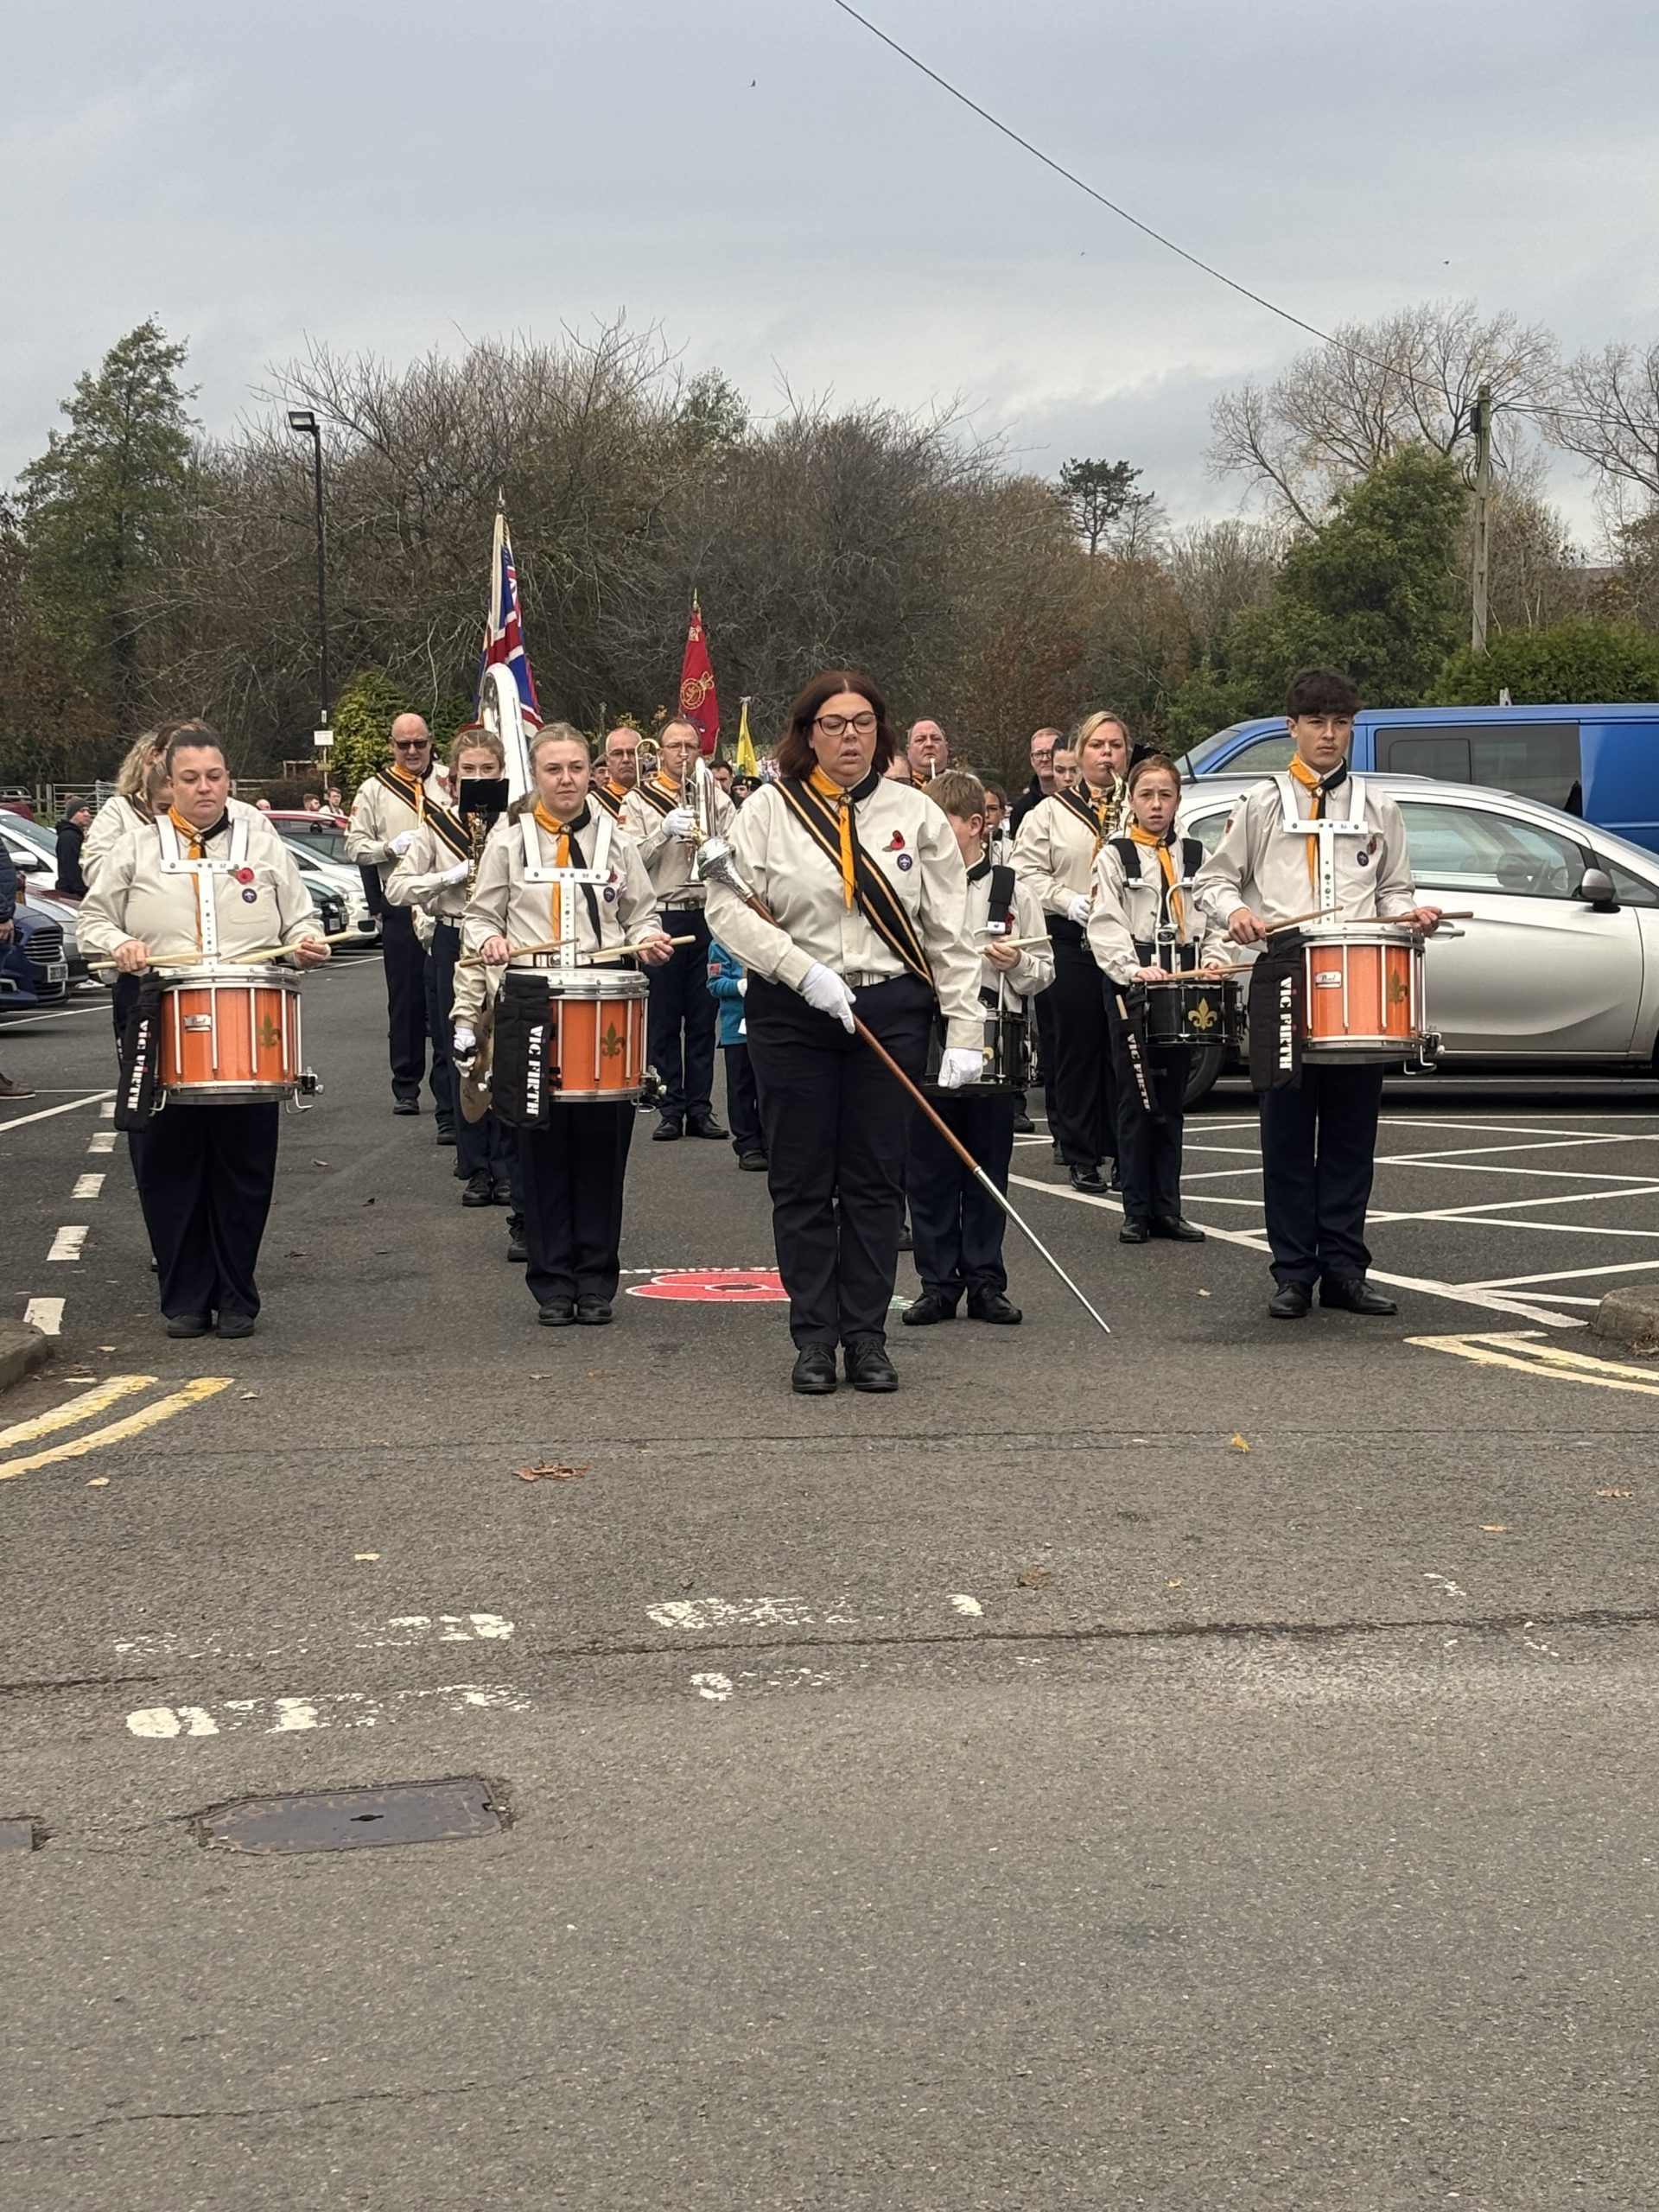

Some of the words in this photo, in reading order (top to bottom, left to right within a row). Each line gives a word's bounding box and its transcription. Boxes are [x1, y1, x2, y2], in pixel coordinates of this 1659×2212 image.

[1279, 976, 1292, 1008] VIC
[137, 1020, 149, 1050] VIC
[528, 1025, 543, 1055] VIC
[1127, 1033, 1141, 1059] VIC
[1279, 1014, 1293, 1071] FIRTH
[127, 1055, 146, 1112] FIRTH
[526, 1059, 541, 1117] FIRTH
[1133, 1064, 1151, 1112] FIRTH
